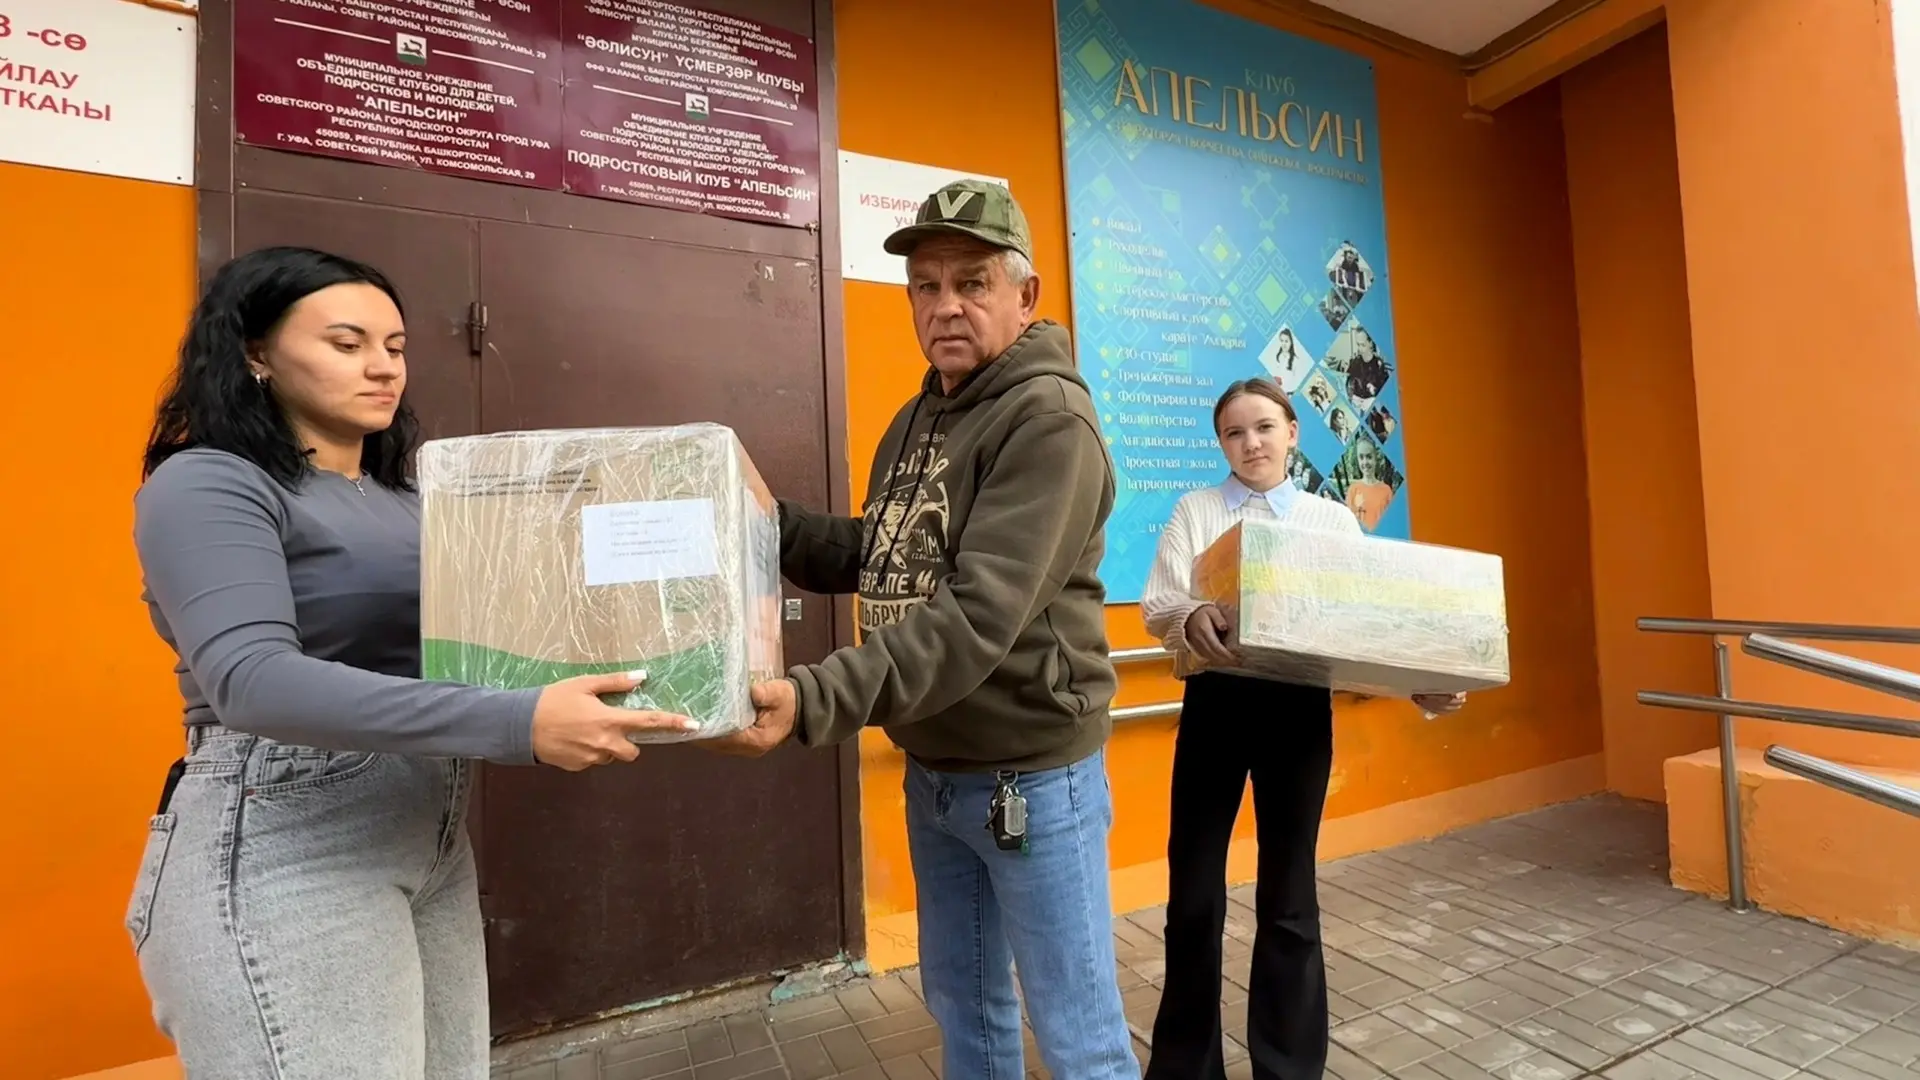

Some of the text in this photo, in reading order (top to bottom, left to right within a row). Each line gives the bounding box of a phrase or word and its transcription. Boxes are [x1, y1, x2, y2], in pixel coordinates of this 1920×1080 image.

[340, 7, 374, 20] СОВЕТ
[377, 14, 423, 31] РАЙОНЫ,
[425, 25, 498, 46] КОМСОМОЛДАР
[499, 42, 534, 57] УРАМЫ,
[536, 50, 547, 59] 29
[652, 30, 688, 42] КЛУБТАР
[678, 16, 711, 29] ОКРУГЫ
[713, 23, 739, 35] СОВЕТ
[631, 34, 690, 52] МУНИЦИПАЛЬ
[297, 58, 517, 107] ОБЪЕДИНЕНИЕ КЛУБОВ ДЛЯ ДЕТЕЙ,
[324, 52, 494, 92] МУНИЦИПАЛЬНОЕ УЧРЕЖДЕНИЕ
[643, 75, 669, 86] СОВЕТ
[756, 71, 804, 94] КЛУБЫ
[324, 74, 494, 113] ПОДРОСТКОВ И МОЛОДЕЖИ
[257, 93, 550, 149] СОВЕТСКОГО РАЙОНА ГОРОДСКОГО ОКРУГА ГОРОД УФА
[1114, 58, 1363, 162] АПЕЛЬСИН
[331, 116, 489, 149] РЕСПУБЛИКИ БАШКОРТОСТАН
[612, 127, 670, 144] ПОДРОСТКОВ
[680, 140, 727, 153] МОЛОДЕЖИ
[623, 121, 769, 153] ОБЪЕДИНЕНИЕ КЛУБОВ ДЛЯ ДЕТЕЙ,
[631, 113, 761, 142] МУНИЦИПАЛЬНОЕ УЧРЕЖДЕНИЕ
[288, 135, 313, 146] УФА,
[315, 138, 378, 155] СОВЕТСКИЙ
[381, 149, 417, 162] РАЙОН,
[420, 156, 434, 165] УЛ.
[437, 157, 523, 178] КОМСОМОЛЬСКАЯ,
[525, 171, 535, 179] 29
[355, 134, 421, 153] РЕСПУБЛИКА
[424, 146, 503, 165] БАШКОРТОСТАН,
[580, 129, 806, 175] СОВЕТСКОГО РАЙОНА ГОРОДСКОГО ОКРУГА ГОРОД УФА
[567, 149, 692, 184] ПОДРОСТКОВЫЙ
[696, 173, 731, 188] КЛУБ
[636, 150, 758, 176] РЕСПУБЛИКИ БАШКОРТОСТАН
[629, 190, 674, 203] СОВЕТСКИЙ
[716, 204, 781, 219] КОМСОМОЛЬСКАЯ,
[657, 186, 705, 199] РЕСПУБЛИКА
[860, 193, 921, 212] ИЗБИРА
[937, 191, 976, 218] V
[1106, 217, 1141, 233] Вокал
[1172, 290, 1232, 308] мастерство
[1113, 304, 1209, 325] Спортивный клуб
[1195, 377, 1213, 386] зал
[1117, 390, 1189, 406] Фотография
[1190, 397, 1198, 405] и
[1119, 412, 1196, 427] Волонтёрство
[1121, 434, 1185, 449] Английский
[1188, 437, 1208, 448] для
[1123, 456, 1217, 470] Проектная школа
[1126, 478, 1210, 492] Патриотическое
